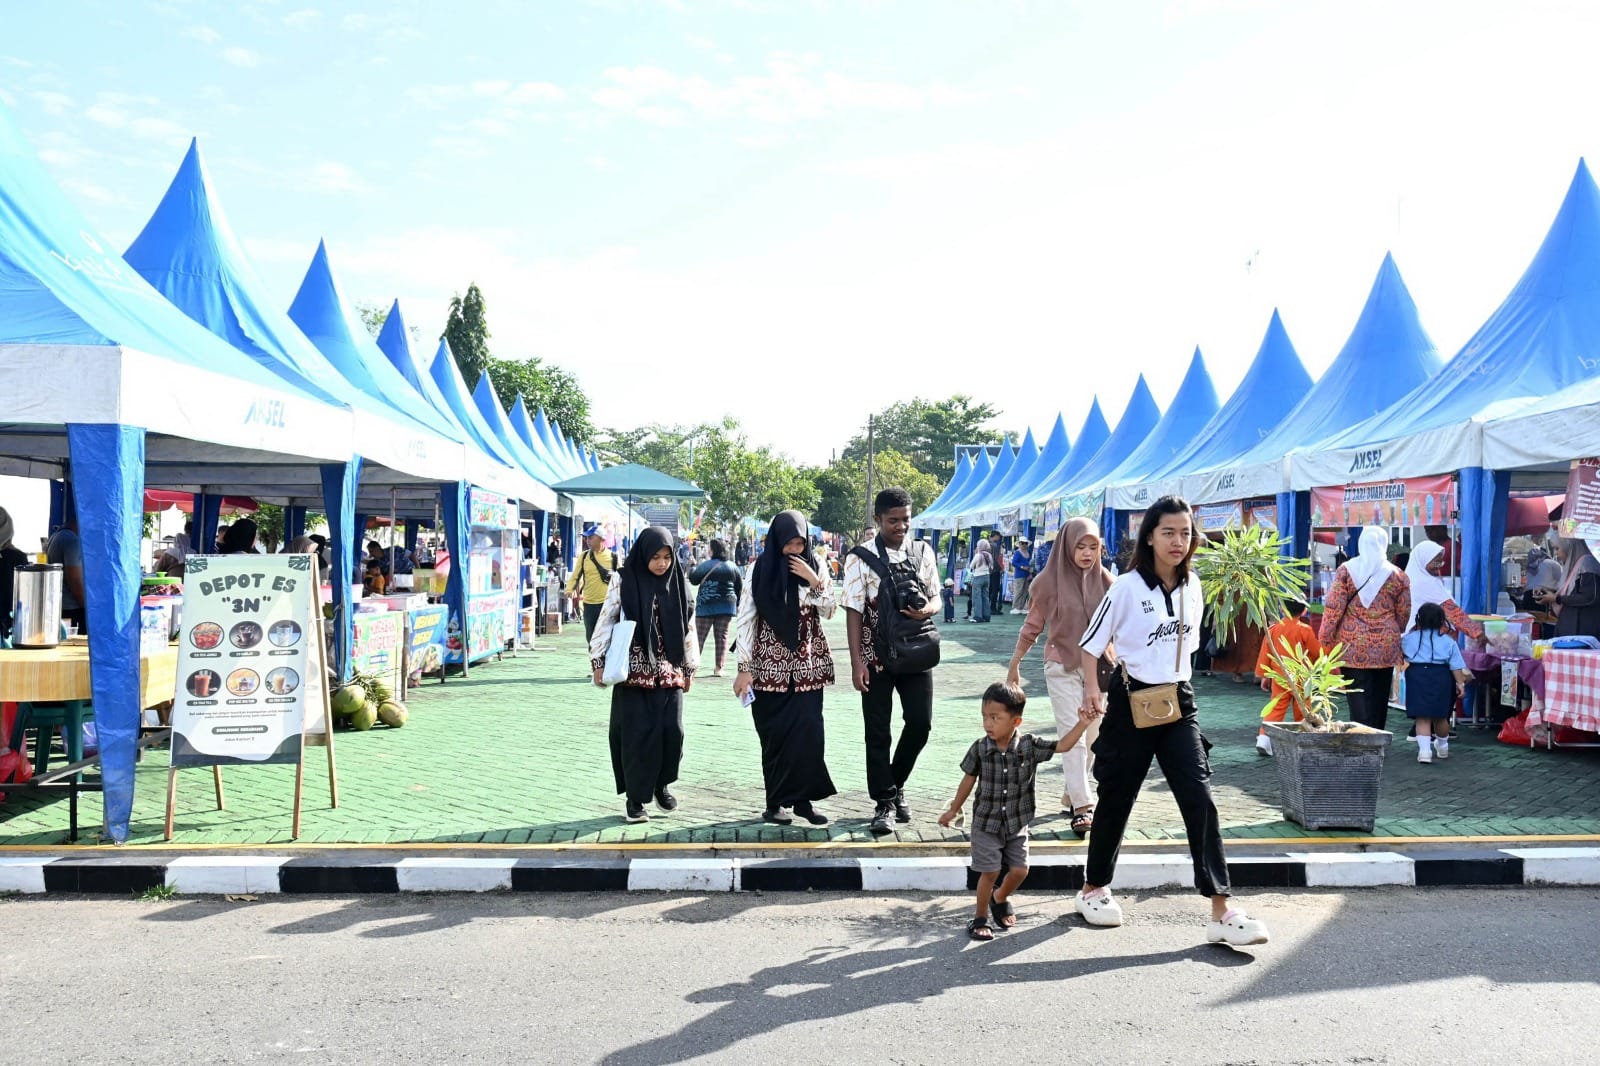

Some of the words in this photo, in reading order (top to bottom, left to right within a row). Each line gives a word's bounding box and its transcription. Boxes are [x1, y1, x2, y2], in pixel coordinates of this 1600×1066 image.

[1385, 484, 1405, 498] SEGAR
[199, 573, 265, 596] DEPOT
[271, 575, 297, 593] ES
